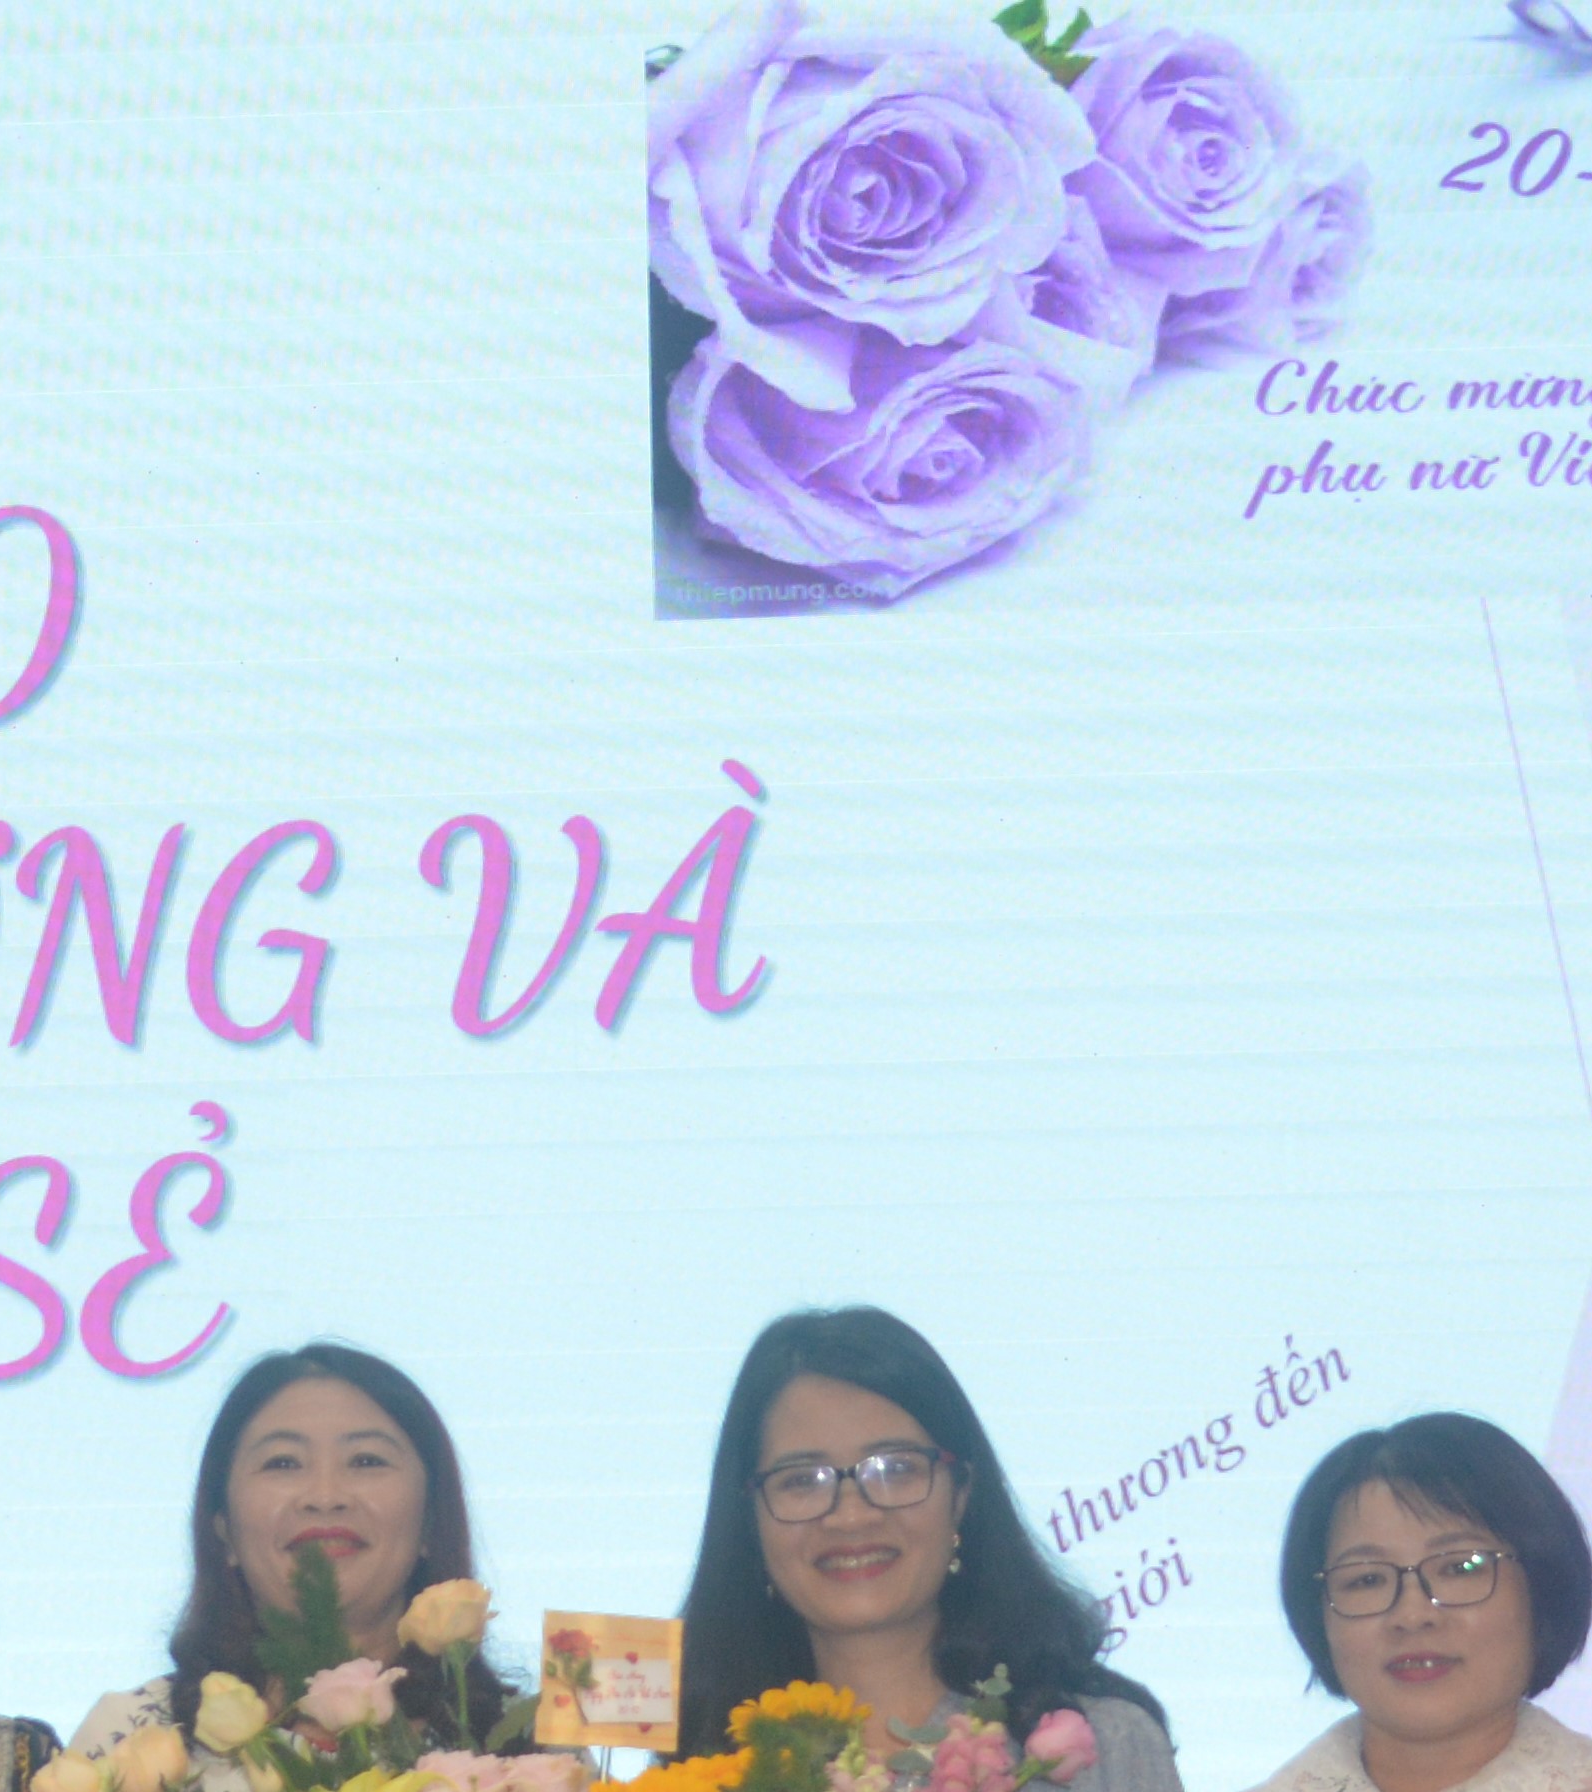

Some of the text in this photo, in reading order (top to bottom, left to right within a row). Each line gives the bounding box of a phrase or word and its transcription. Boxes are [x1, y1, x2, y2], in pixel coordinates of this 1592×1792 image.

[1254, 358, 1427, 417] Chúc
[1243, 438, 1388, 520] phụ
[1408, 453, 1502, 491] nữ
[418, 757, 770, 1037] VÀ
[1046, 1333, 1352, 1554] thương đến
